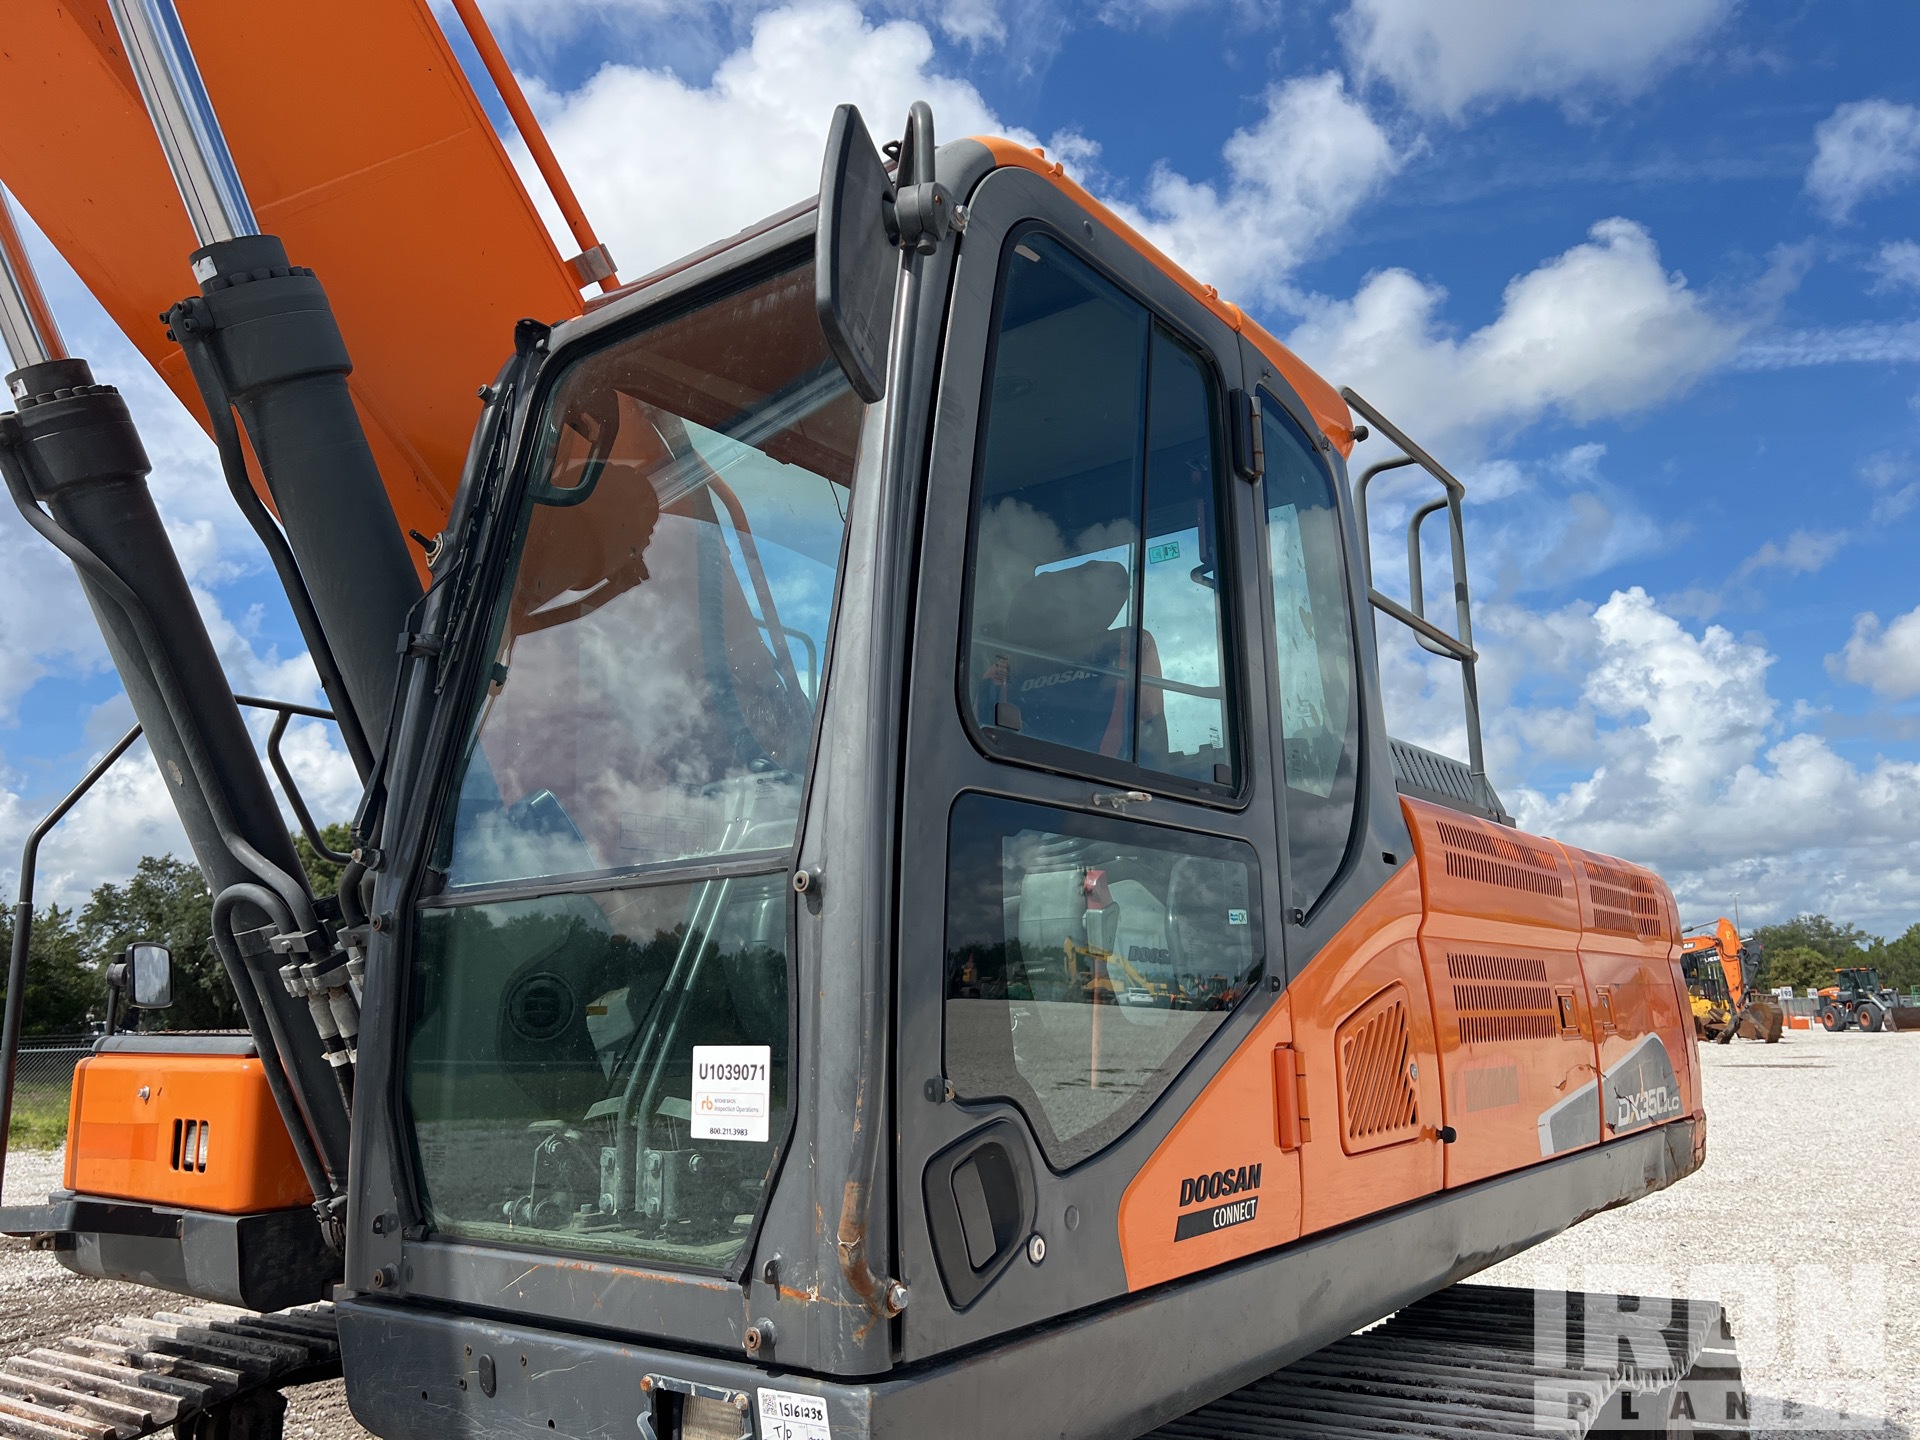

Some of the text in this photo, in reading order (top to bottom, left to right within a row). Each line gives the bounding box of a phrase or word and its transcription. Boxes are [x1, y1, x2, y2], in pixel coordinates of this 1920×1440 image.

[1128, 945, 1171, 964] DOOS
[699, 1063, 765, 1080] U1039071
[709, 1127, 748, 1136] 800.211.3983
[1179, 1163, 1262, 1207] DOOSAN
[1212, 1199, 1257, 1228] CONNECT
